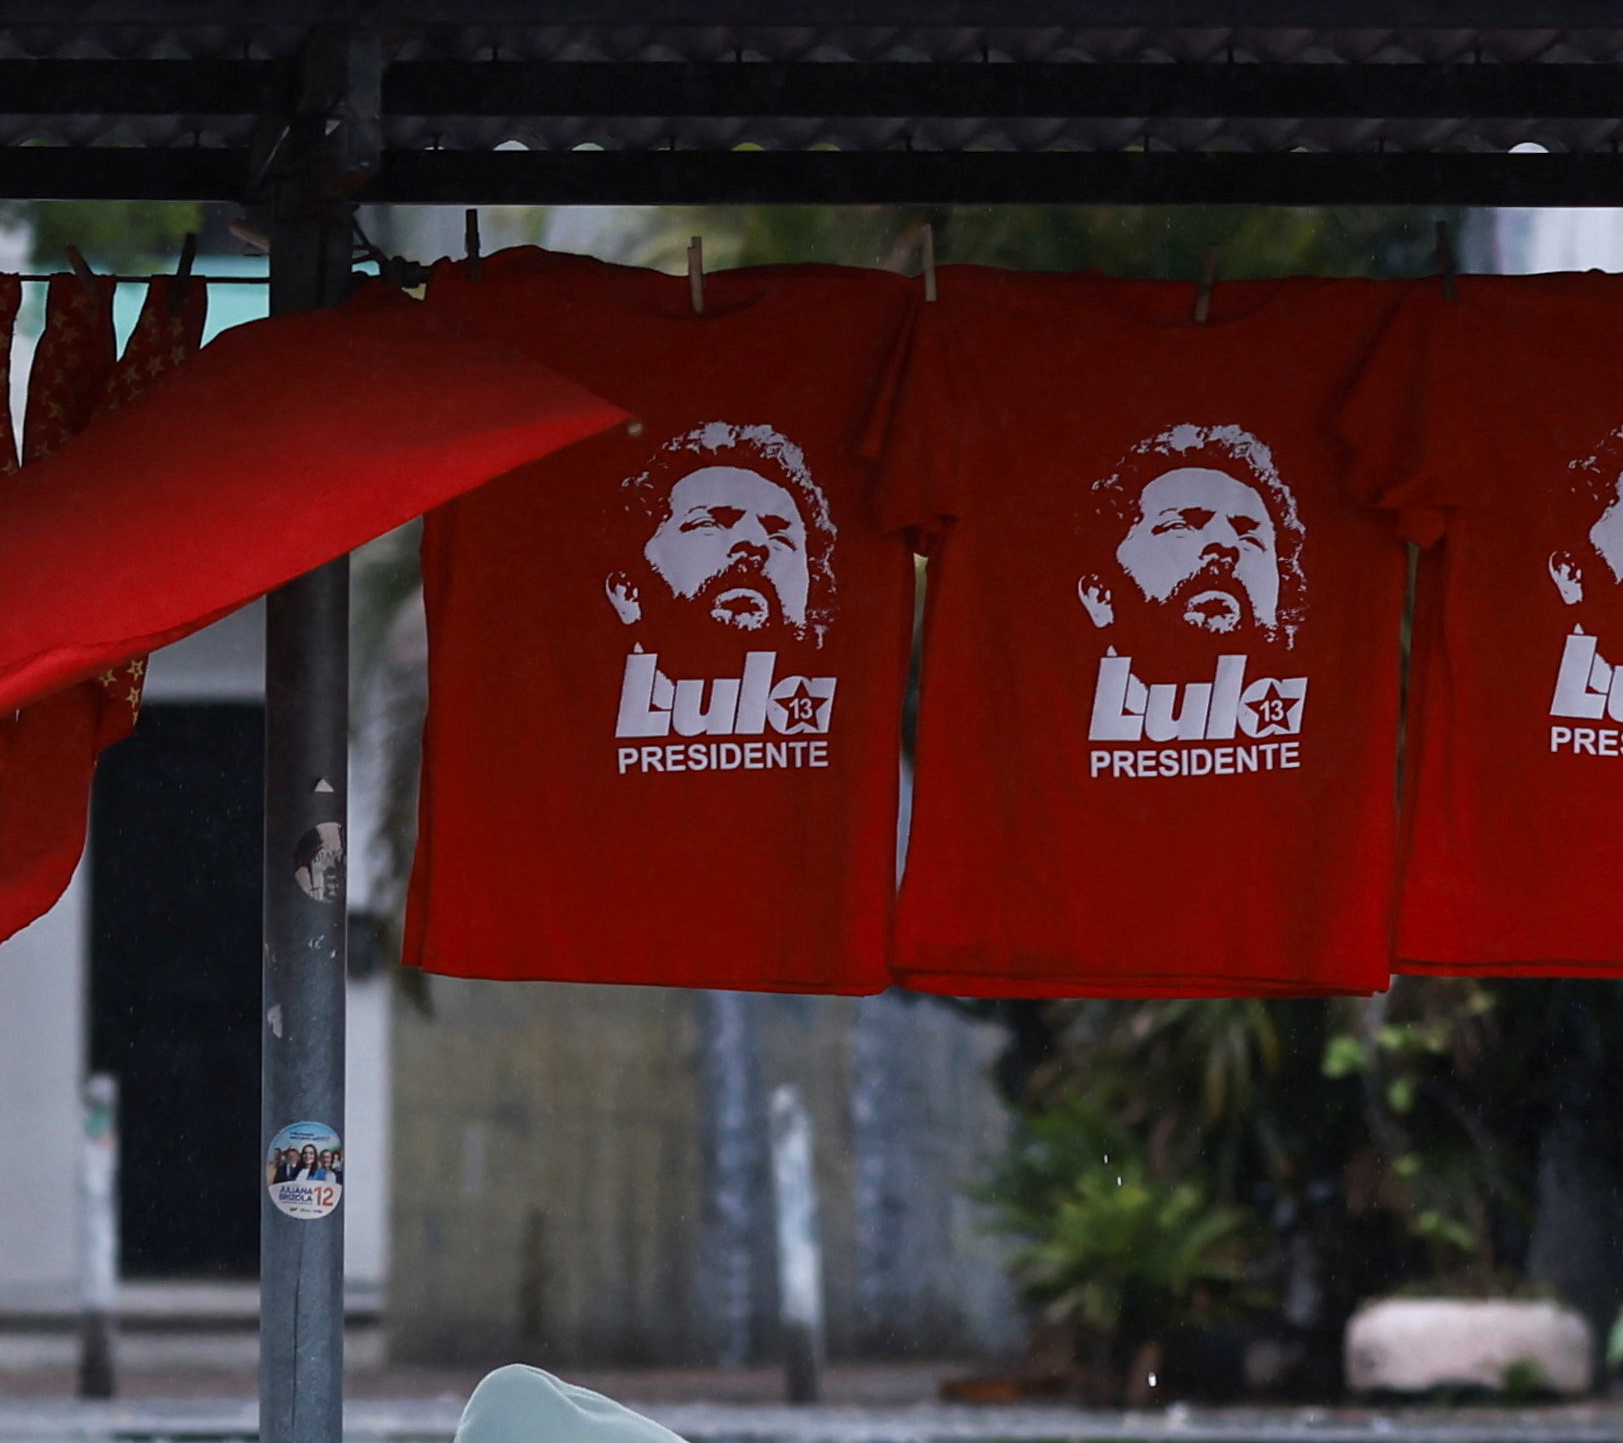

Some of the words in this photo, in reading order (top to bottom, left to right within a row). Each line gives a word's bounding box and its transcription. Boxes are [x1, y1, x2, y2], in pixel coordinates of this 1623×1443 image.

[615, 651, 837, 738] Lula
[789, 698, 813, 719] 13
[1088, 655, 1308, 742] Lula
[1259, 700, 1284, 722] 13
[618, 741, 828, 774] PRESIDENTE
[1091, 742, 1300, 777] PRESIDENTE
[314, 1186, 334, 1206] 12
